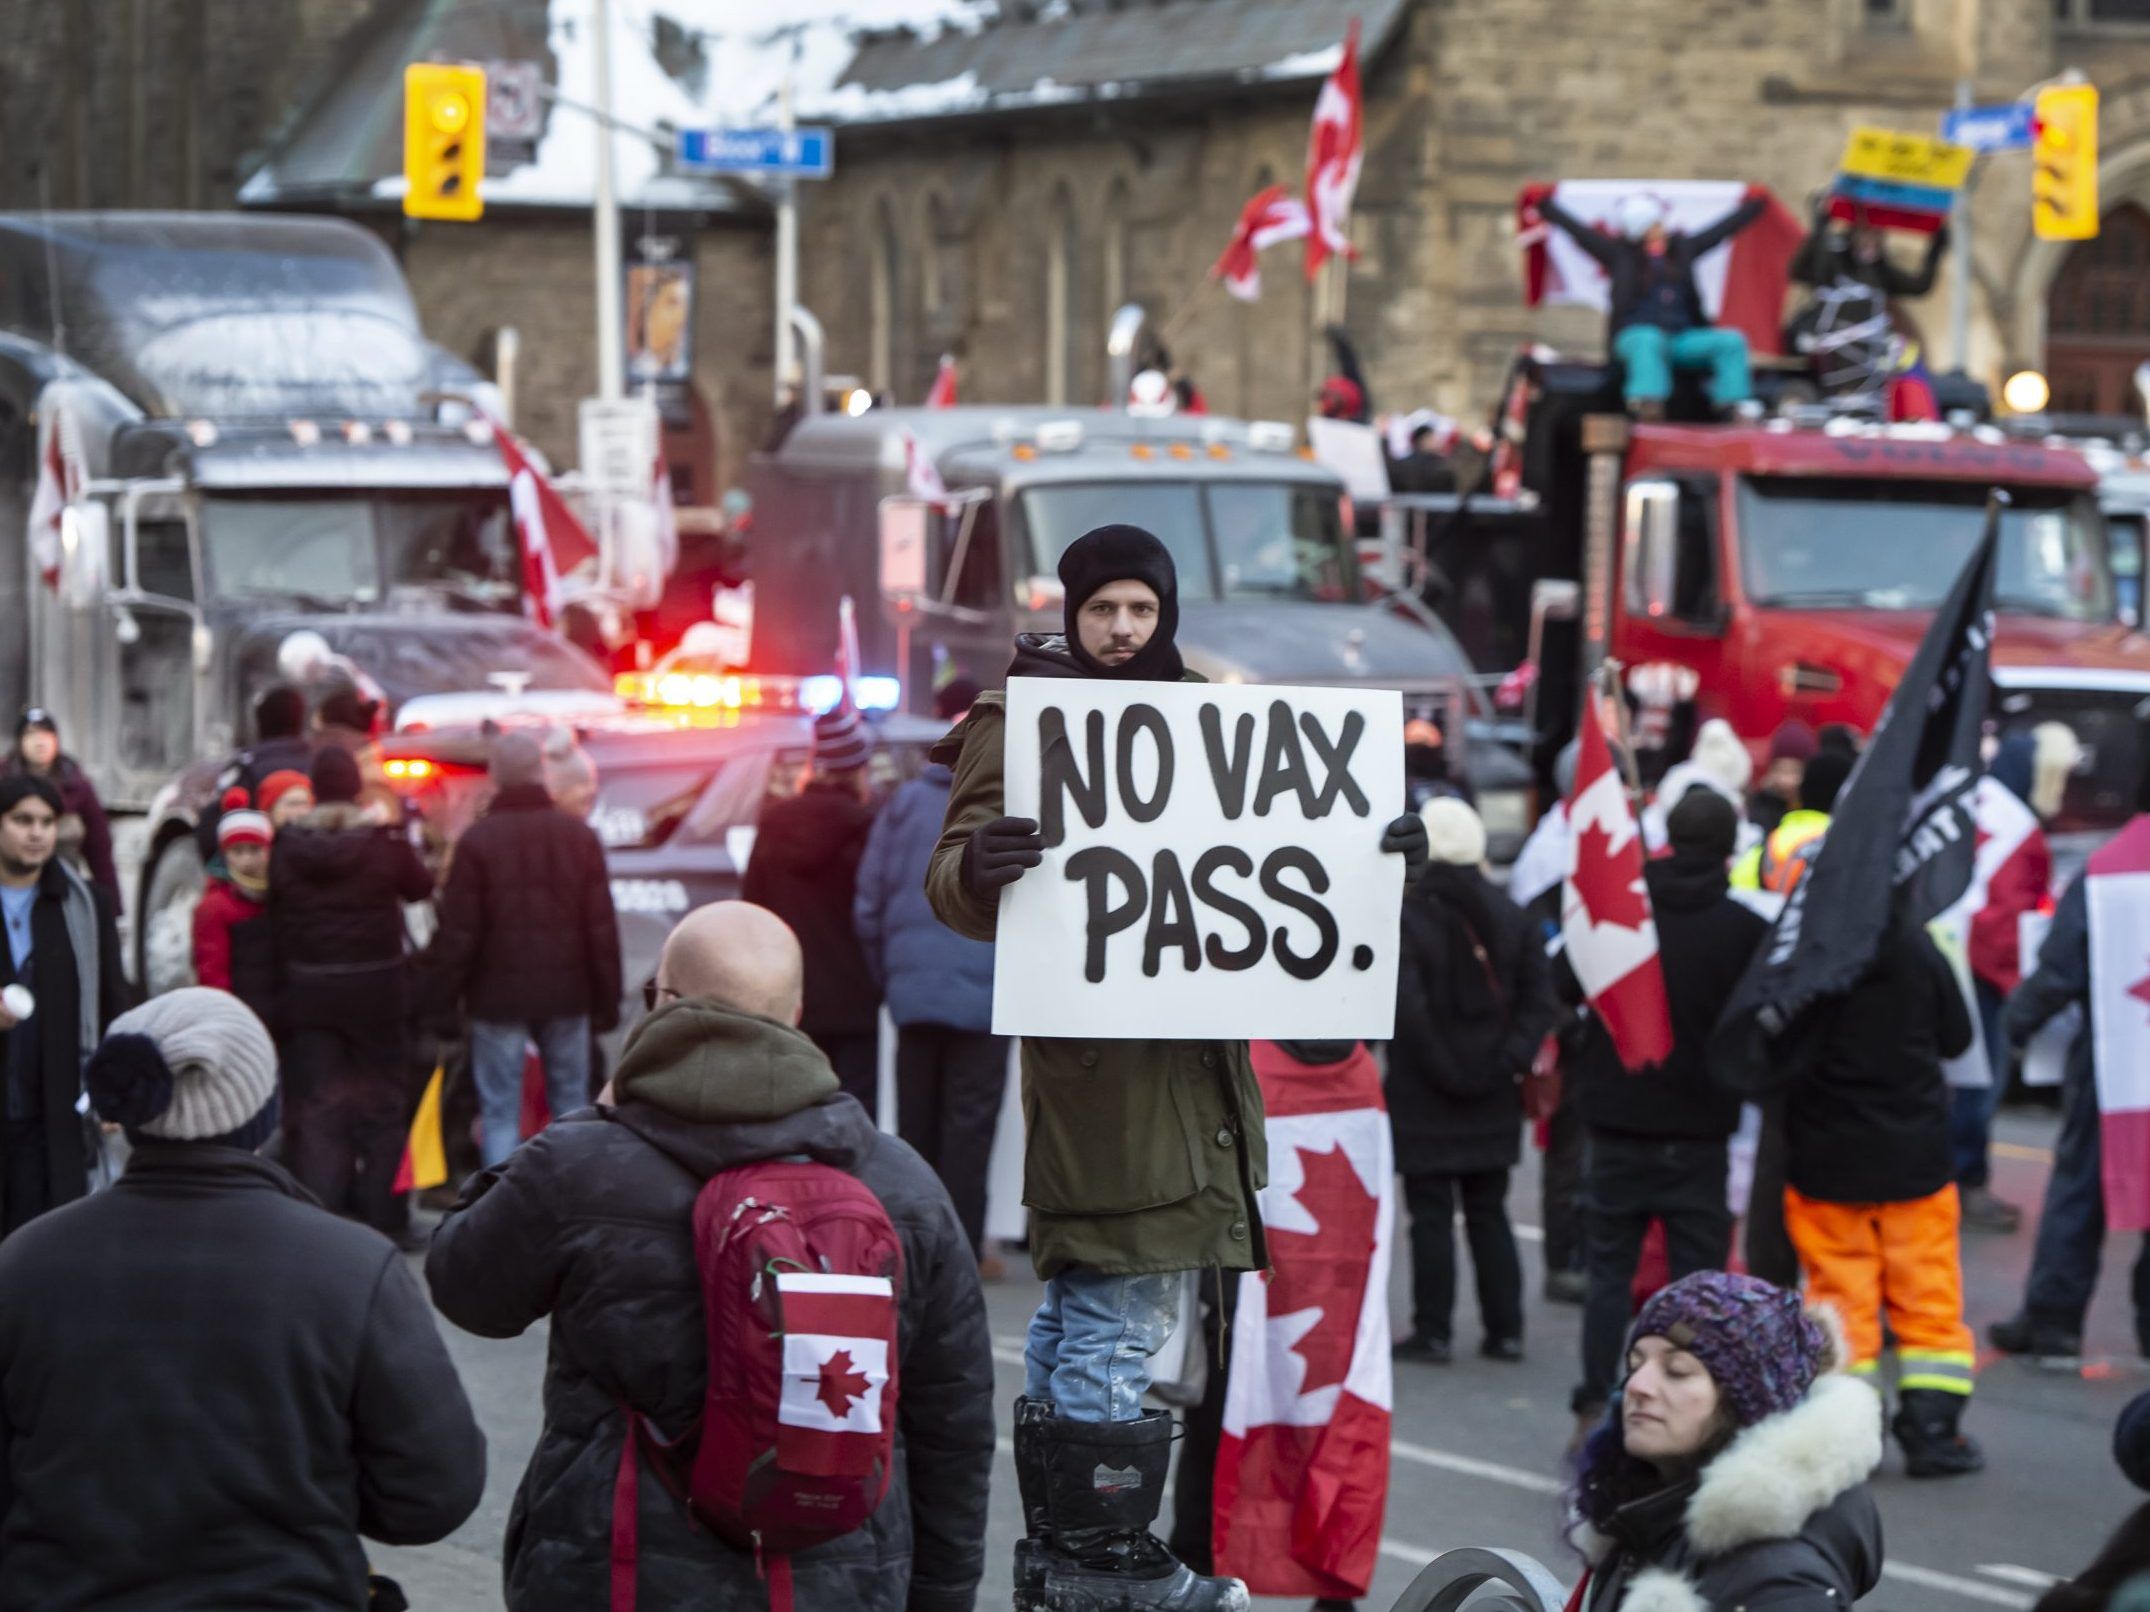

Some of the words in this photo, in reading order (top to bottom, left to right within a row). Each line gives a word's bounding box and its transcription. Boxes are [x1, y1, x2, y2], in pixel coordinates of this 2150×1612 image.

[1038, 703, 1175, 848] NO
[1199, 699, 1370, 820] VAX
[1064, 845, 1375, 983] PASS.
